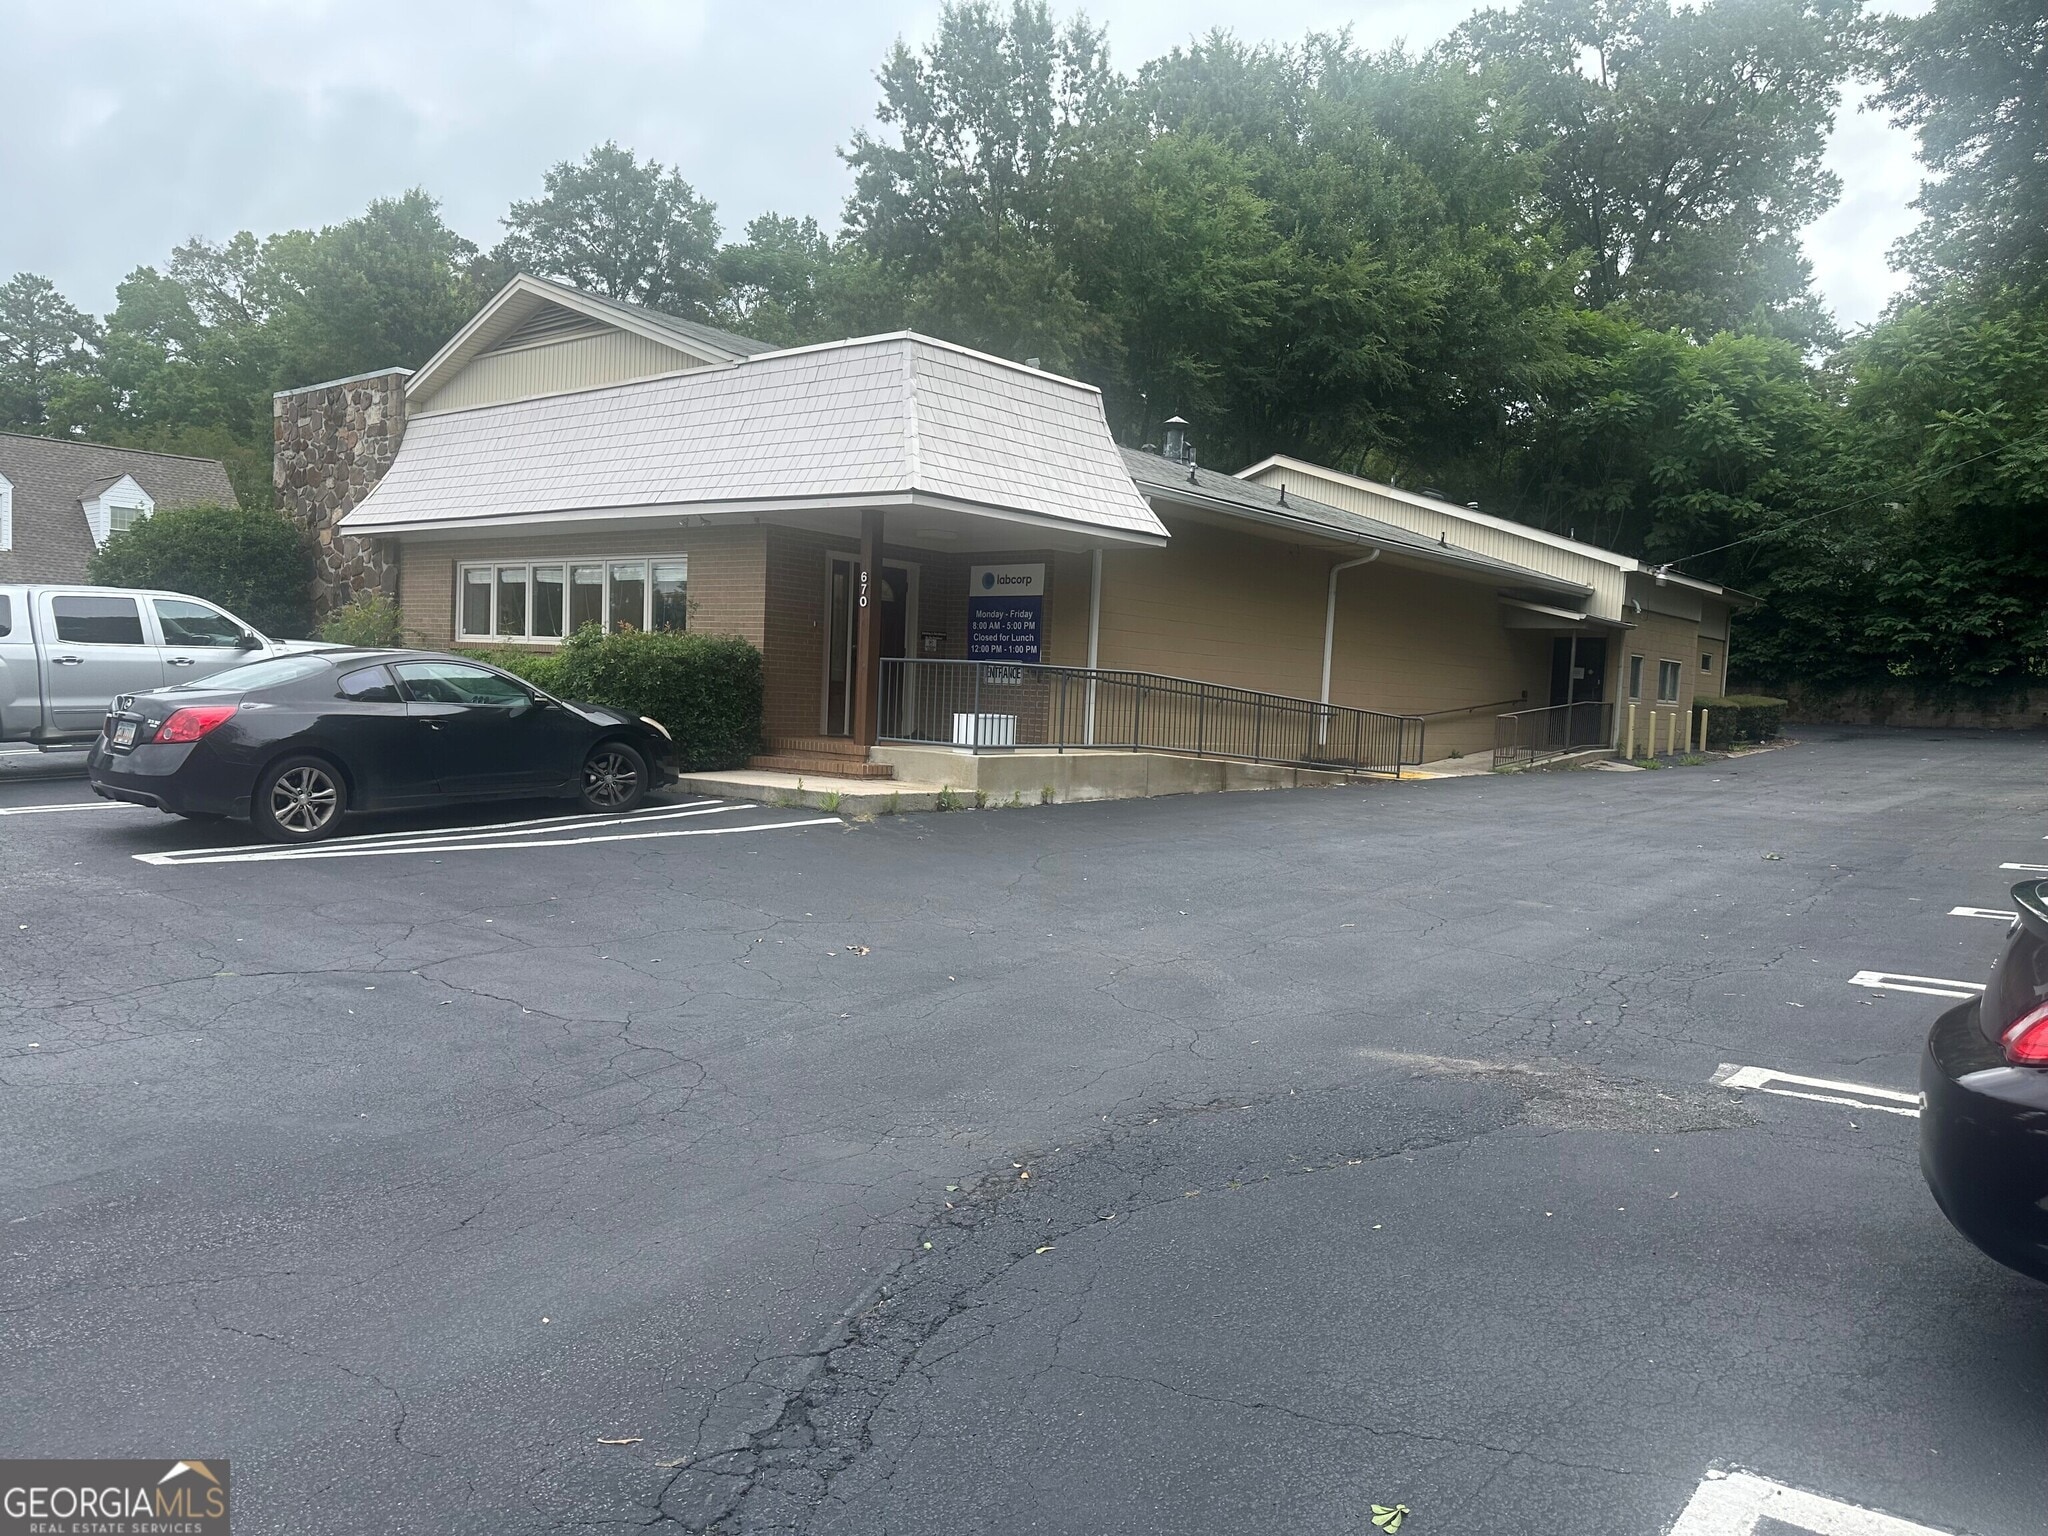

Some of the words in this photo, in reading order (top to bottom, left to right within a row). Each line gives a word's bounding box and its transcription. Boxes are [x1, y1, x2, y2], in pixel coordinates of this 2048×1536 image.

[997, 574, 1032, 586] labcorp
[859, 571, 868, 607] 670
[975, 609, 1004, 620] Monday
[1009, 609, 1033, 620] Friday
[972, 621, 987, 630] 8:00
[988, 621, 1001, 630] AM
[1006, 621, 1022, 630] 5:00
[1023, 621, 1036, 630] PM
[973, 632, 998, 641] Closed
[999, 633, 1010, 641] for
[1011, 633, 1034, 642] Lunch
[971, 644, 990, 653] 12:00
[990, 644, 1003, 653] PM
[1008, 645, 1024, 654] 1:00
[1025, 645, 1038, 654] PM
